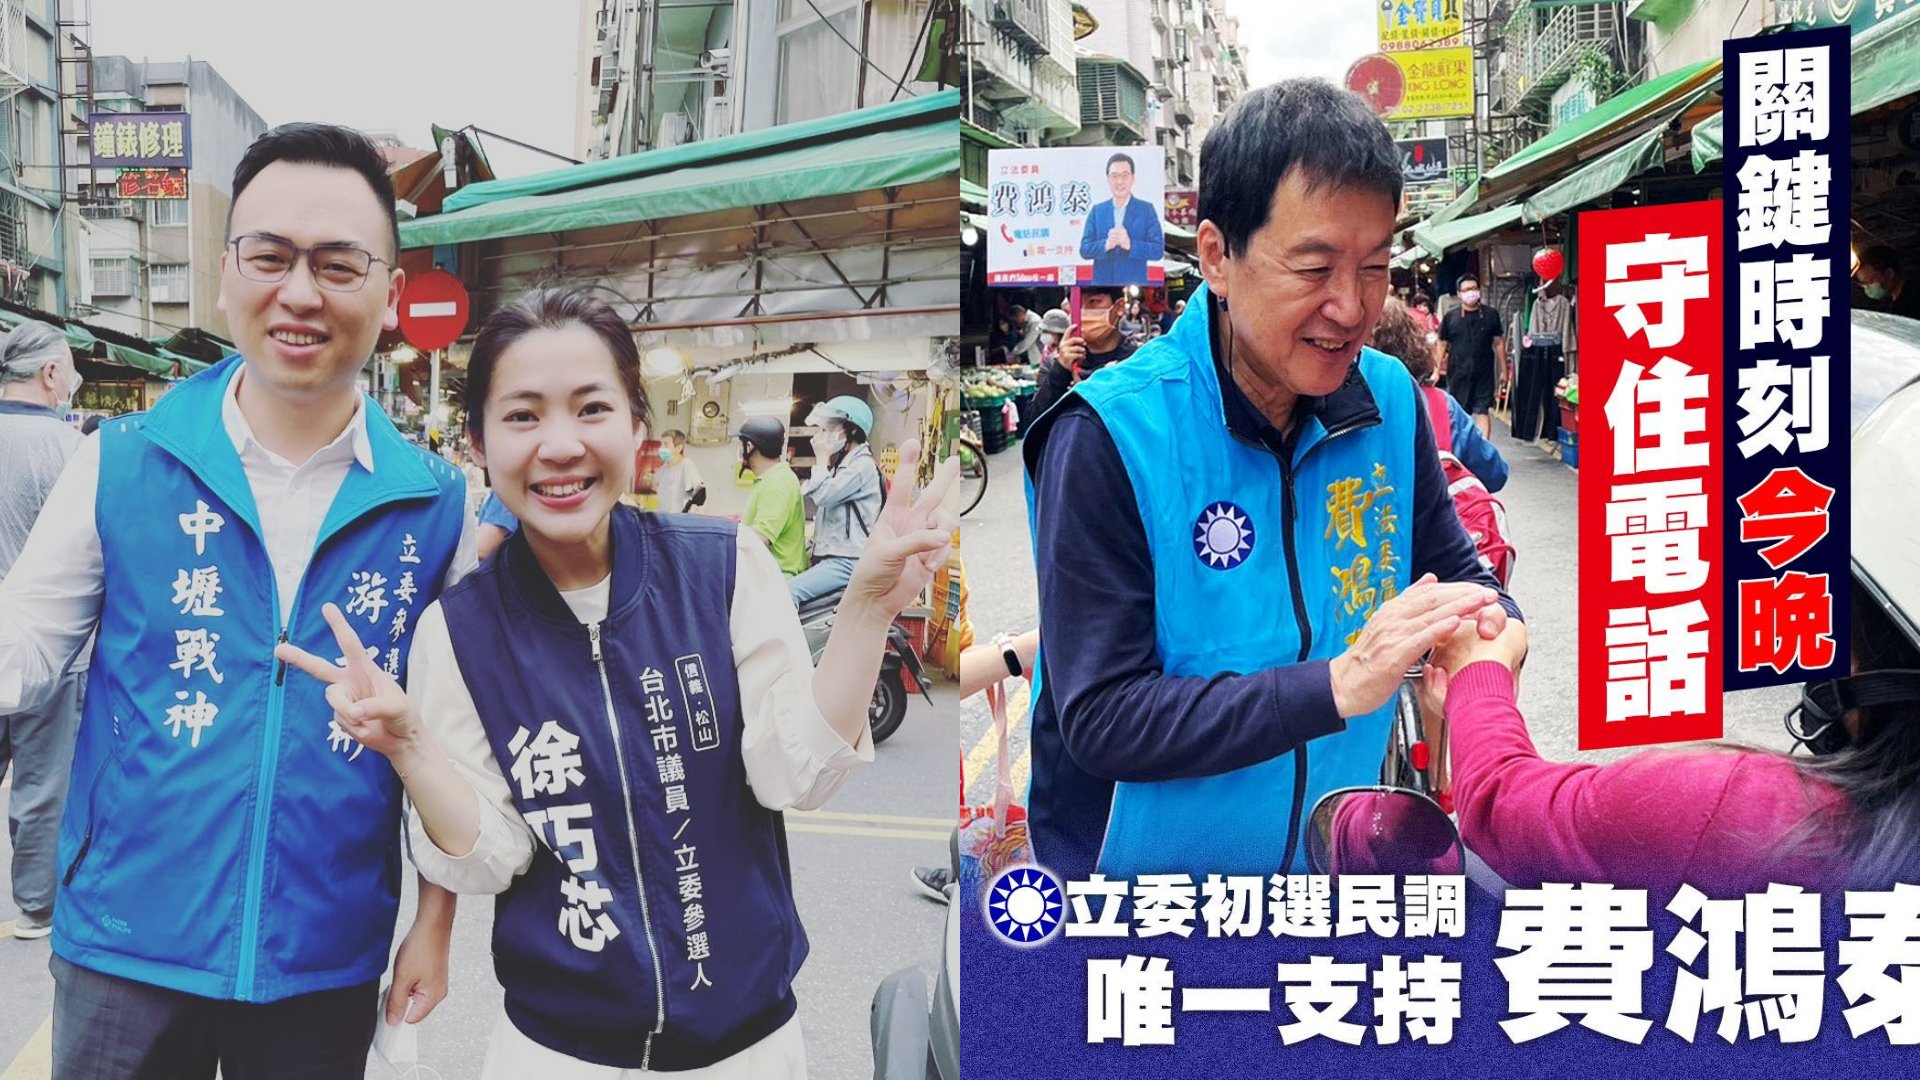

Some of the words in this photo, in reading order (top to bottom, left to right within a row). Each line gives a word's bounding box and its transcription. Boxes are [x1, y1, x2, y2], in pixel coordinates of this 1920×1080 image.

[93, 121, 184, 158] 鐘錶修理
[995, 184, 1087, 214] 費鴻泰
[163, 500, 226, 748] 中壢戰神
[1325, 477, 1375, 646] 費鴻
[506, 720, 621, 952] 徐巧芯
